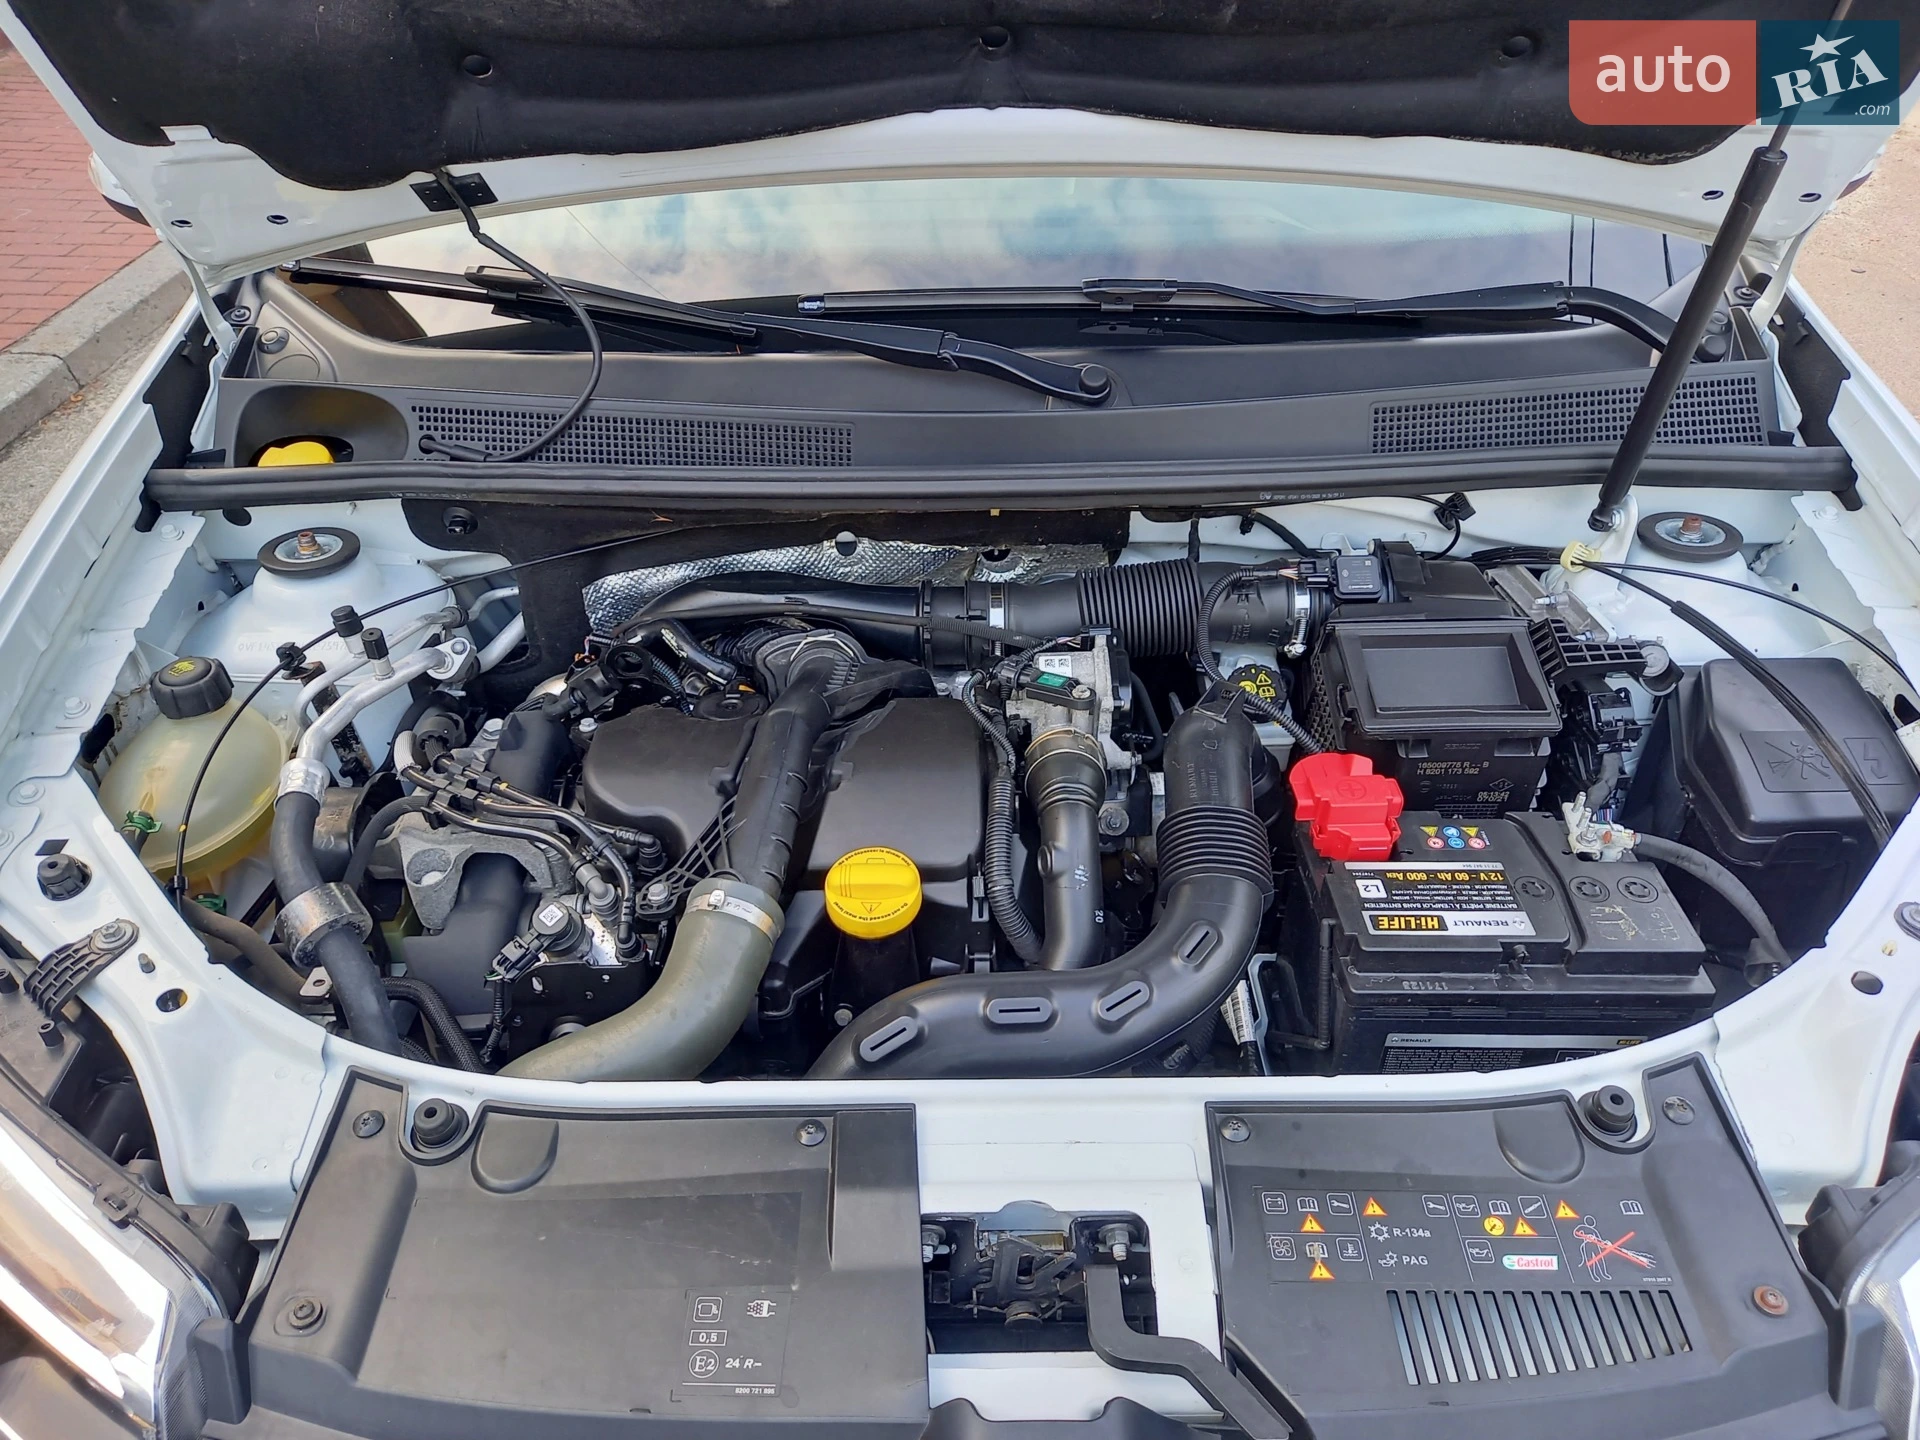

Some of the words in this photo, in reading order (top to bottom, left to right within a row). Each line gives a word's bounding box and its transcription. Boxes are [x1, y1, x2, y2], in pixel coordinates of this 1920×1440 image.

[1406, 872, 1428, 881] 600
[1436, 872, 1452, 881] Ah
[1454, 872, 1470, 881] 60
[1479, 872, 1489, 881] V
[1488, 872, 1505, 881] 12
[1362, 884, 1381, 893] L2
[1377, 916, 1440, 929] Hi-LIFE
[1452, 919, 1510, 927] RENAULT
[1392, 1226, 1432, 1239] R-134a
[1402, 1254, 1429, 1267] PAG
[1516, 1255, 1555, 1269] Castrol
[698, 1332, 718, 1344] 0,5
[693, 1355, 716, 1373] E2
[725, 1357, 740, 1369] 24
